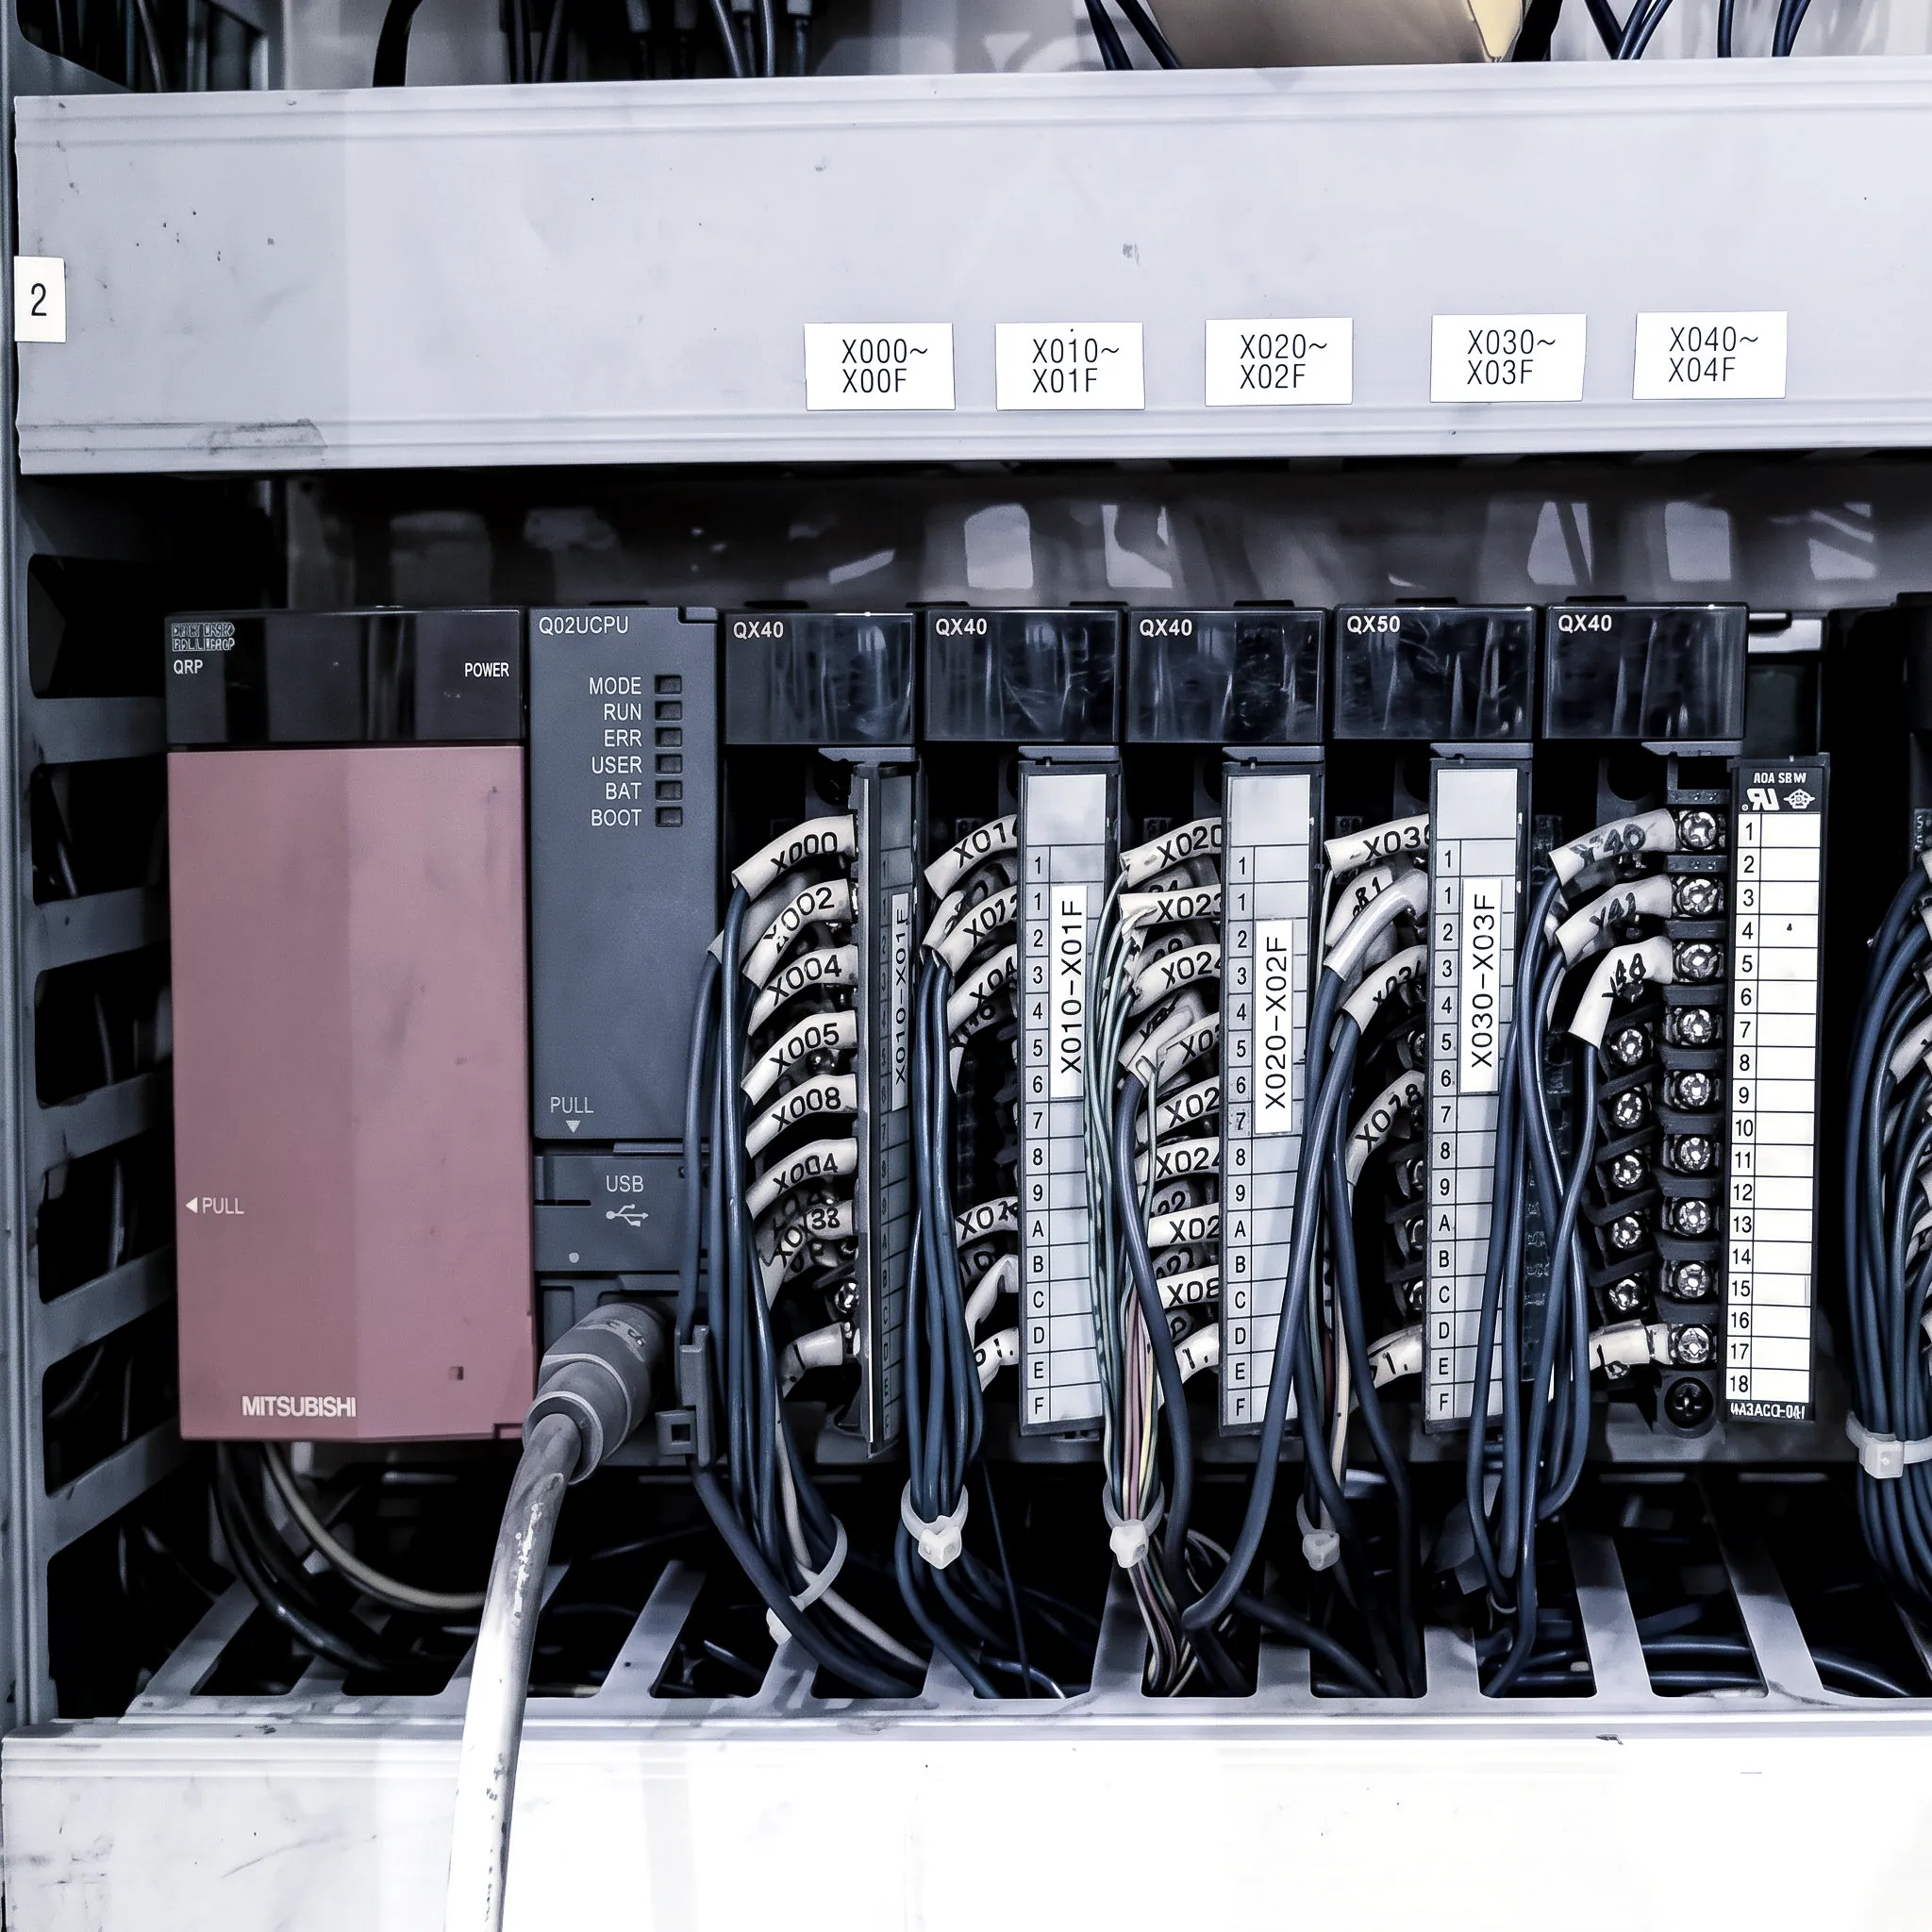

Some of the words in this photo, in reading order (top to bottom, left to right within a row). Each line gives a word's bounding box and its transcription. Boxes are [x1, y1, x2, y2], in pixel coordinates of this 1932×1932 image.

[31, 283, 46, 316] 2
[1240, 363, 1306, 389] X02F
[1467, 359, 1533, 385] X03F
[1669, 357, 1736, 382] X04F
[841, 368, 907, 393] X00F
[1032, 368, 1097, 393] X01F
[539, 616, 628, 635] Q02UCPU
[734, 621, 783, 640] QX40
[936, 618, 987, 637] QX40
[1140, 619, 1191, 637] QX40
[1347, 615, 1400, 635] QX50
[1558, 614, 1611, 633] QX40
[174, 659, 203, 675] QRP
[465, 662, 509, 677] POWER
[590, 676, 641, 694] MODE
[604, 703, 641, 721] RUN
[605, 729, 641, 746] ERR
[592, 756, 641, 774] USER
[606, 782, 641, 800] BAT
[591, 809, 641, 826] BOOT
[1745, 823, 1753, 841] 1
[771, 831, 838, 875] X000
[1444, 850, 1451, 868] 1
[1034, 856, 1041, 874] 1
[1239, 857, 1245, 874] 1
[1743, 855, 1755, 874] 2
[1034, 892, 1041, 910] 1
[1238, 893, 1245, 911] 1
[1444, 887, 1451, 905] 1
[1743, 889, 1754, 907] 3
[1034, 929, 1043, 947] 2
[1238, 930, 1247, 948] 2
[1443, 923, 1453, 941] 2
[1741, 922, 1754, 940] 4
[1442, 959, 1452, 977] 3
[1741, 955, 1753, 973] 5
[766, 954, 841, 1007] X004
[1033, 966, 1042, 984] 3
[1237, 967, 1246, 985] 3
[1472, 894, 1494, 1068] X030-X03F
[1060, 901, 1082, 1074] X010-X01F
[1441, 996, 1452, 1014] 4
[1740, 988, 1752, 1006] 6
[1032, 1002, 1042, 1020] 4
[1237, 1003, 1247, 1021] 4
[1265, 937, 1287, 1109] X020-X02F
[1740, 1021, 1751, 1038] 7
[769, 1022, 840, 1076] X005
[1033, 1039, 1042, 1057] 5
[1237, 1040, 1246, 1058] 5
[1441, 1033, 1452, 1051] 5
[1740, 1054, 1750, 1072] 8
[1033, 1075, 1042, 1093] 6
[1236, 1076, 1246, 1094] 6
[1441, 1069, 1451, 1087] 6
[551, 1096, 594, 1113] PULL
[1739, 1087, 1749, 1104] 9
[772, 1086, 841, 1132] X008
[1441, 1106, 1451, 1124] 7
[1033, 1112, 1042, 1129] 7
[1236, 1112, 1246, 1130] 7
[1736, 1119, 1753, 1137] 10
[1033, 1148, 1042, 1166] 8
[1236, 1148, 1245, 1166] 8
[1441, 1141, 1450, 1159] 8
[1735, 1152, 1751, 1169] 11
[773, 1153, 838, 1195] X004
[607, 1175, 643, 1192] USB
[1440, 1178, 1450, 1196] 9
[1734, 1183, 1753, 1201] 12
[1033, 1184, 1042, 1202] 9
[1236, 1184, 1245, 1202] 9
[203, 1197, 244, 1214] PULL
[1032, 1220, 1043, 1238] A
[1234, 1220, 1246, 1238] A
[1439, 1214, 1450, 1232] A
[1733, 1216, 1752, 1233] 13
[1033, 1256, 1043, 1273] B
[1236, 1256, 1245, 1274] B
[1440, 1250, 1449, 1268] B
[1733, 1248, 1751, 1265] 14
[1439, 1286, 1450, 1304] C
[1732, 1280, 1750, 1297] 15
[1033, 1291, 1044, 1308] C
[1235, 1291, 1245, 1308] C
[1731, 1311, 1749, 1328] 16
[1034, 1326, 1044, 1344] D
[1235, 1327, 1246, 1345] D
[1439, 1322, 1450, 1340] D
[1731, 1343, 1749, 1359] 17
[1034, 1361, 1043, 1379] E
[1236, 1362, 1245, 1380] E
[1439, 1357, 1449, 1375] E
[1730, 1374, 1748, 1392] 18
[242, 1396, 356, 1417] MITSUBISHI
[1035, 1397, 1044, 1415] F
[1236, 1398, 1245, 1417] F
[1440, 1393, 1449, 1411] F
